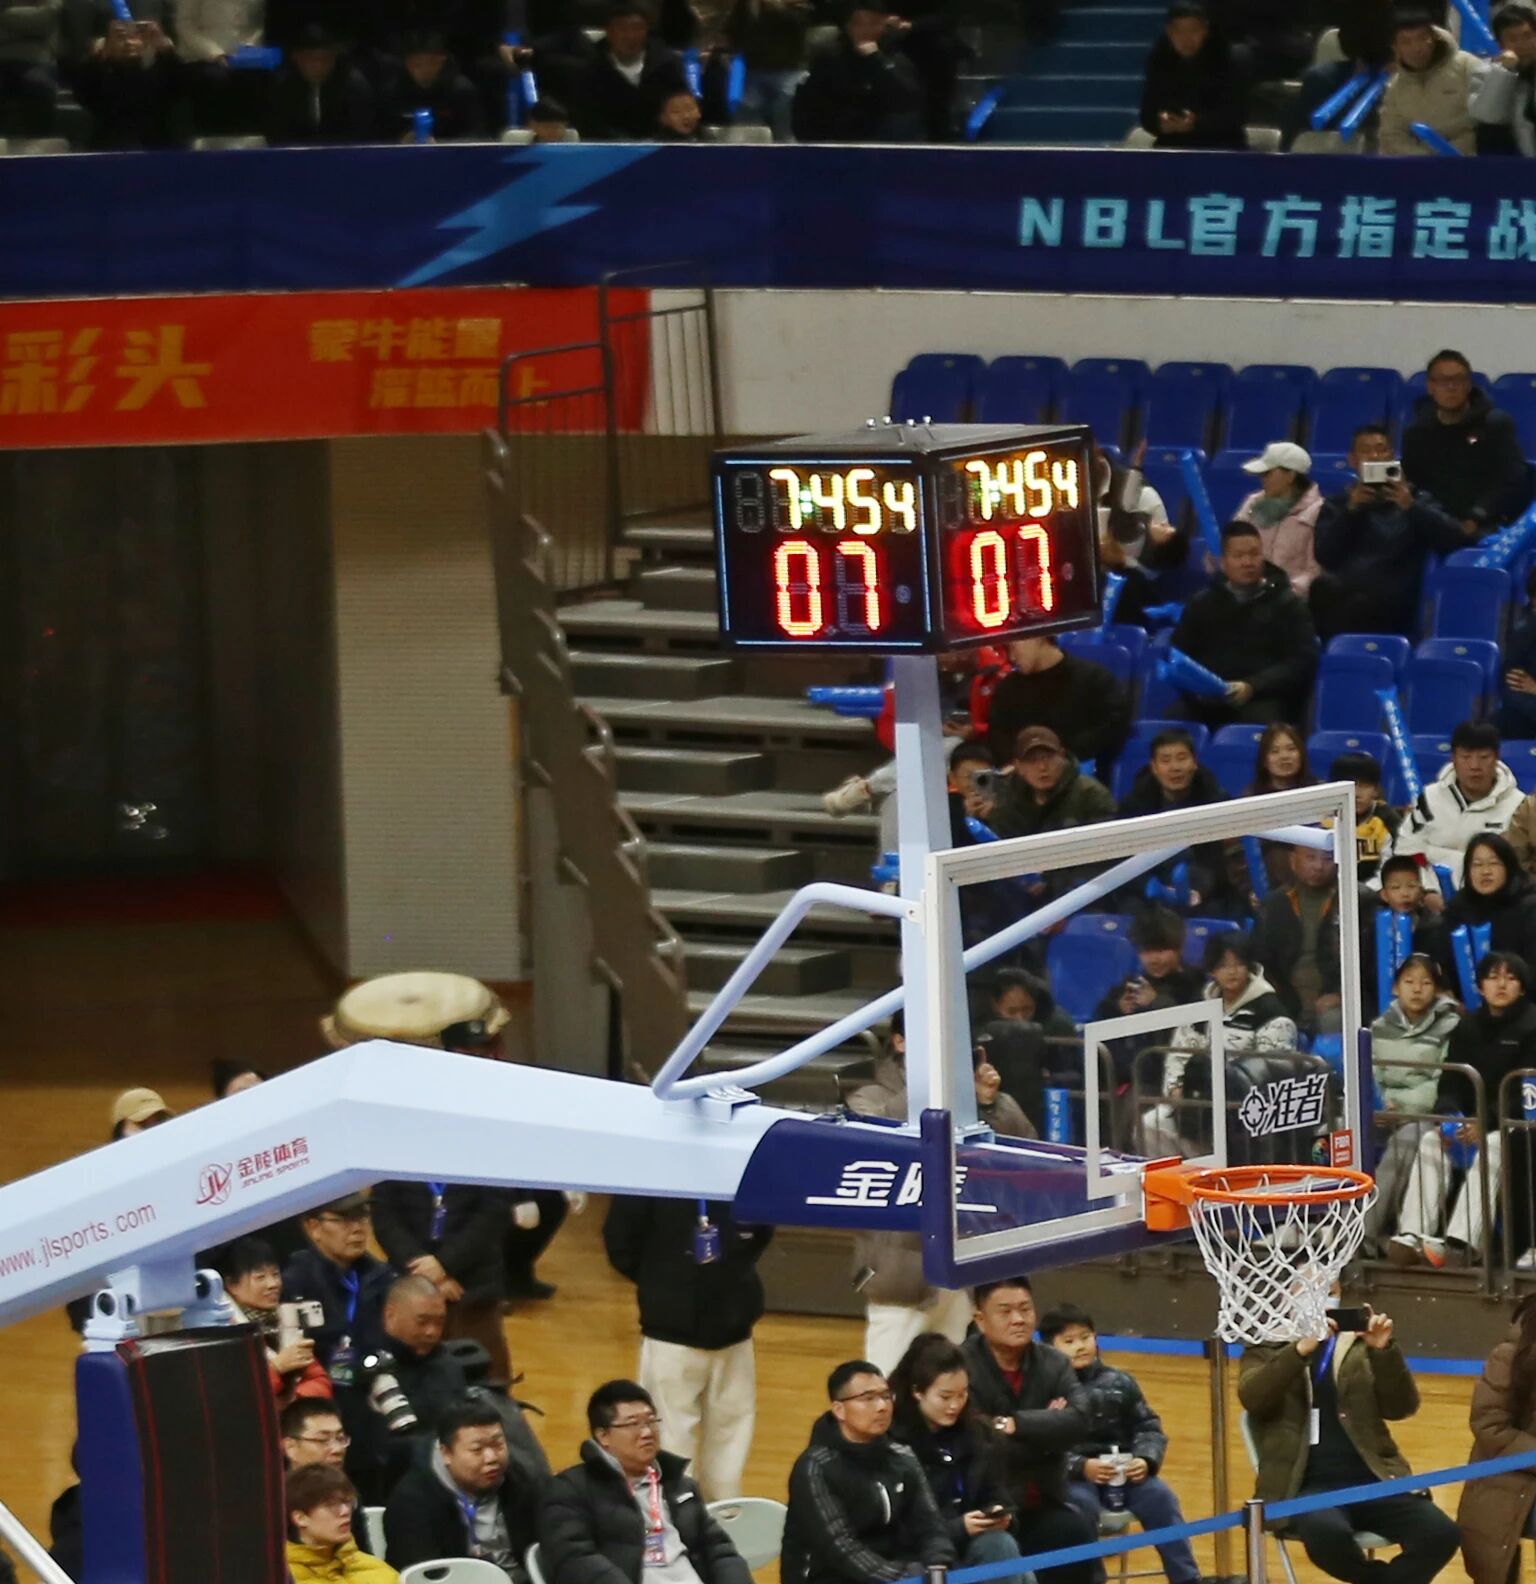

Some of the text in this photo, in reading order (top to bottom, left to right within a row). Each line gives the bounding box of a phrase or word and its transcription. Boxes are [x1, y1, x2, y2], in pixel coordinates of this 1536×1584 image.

[773, 540, 880, 636] 07
[970, 524, 1053, 628] 07
[237, 1136, 310, 1178] 金陵体育
